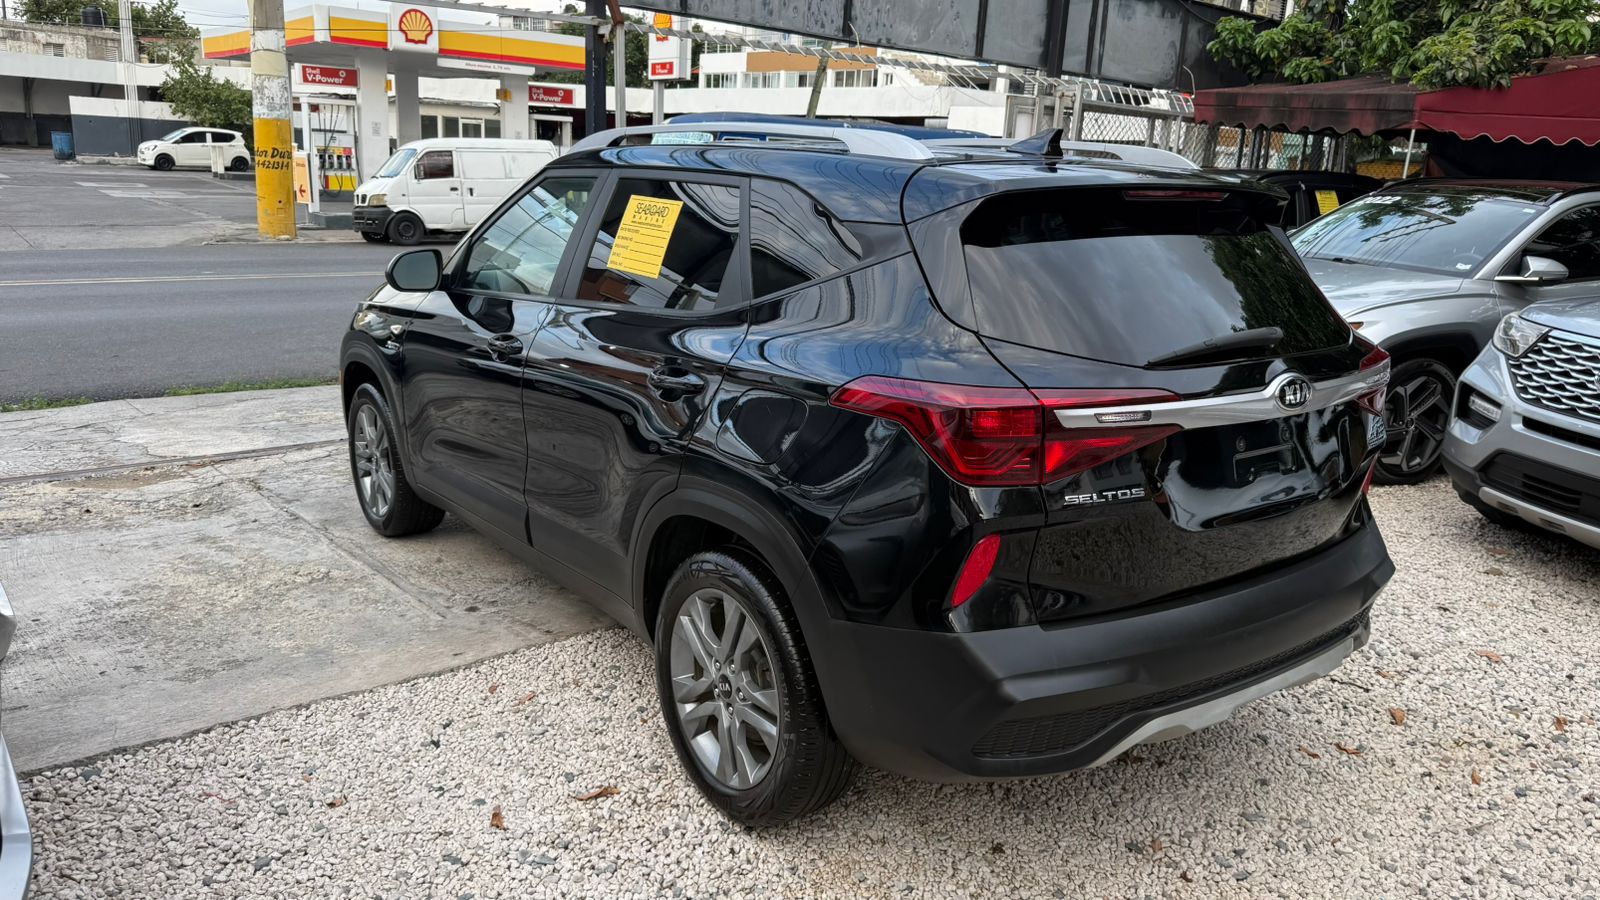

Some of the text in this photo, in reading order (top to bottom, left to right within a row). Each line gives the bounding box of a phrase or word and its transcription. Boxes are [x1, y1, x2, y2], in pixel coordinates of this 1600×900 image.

[306, 74, 344, 84] V-Power
[532, 93, 562, 102] V-Power
[1284, 382, 1309, 405] KIA
[1064, 488, 1145, 505] SELTOS
[719, 682, 731, 691] KIA
